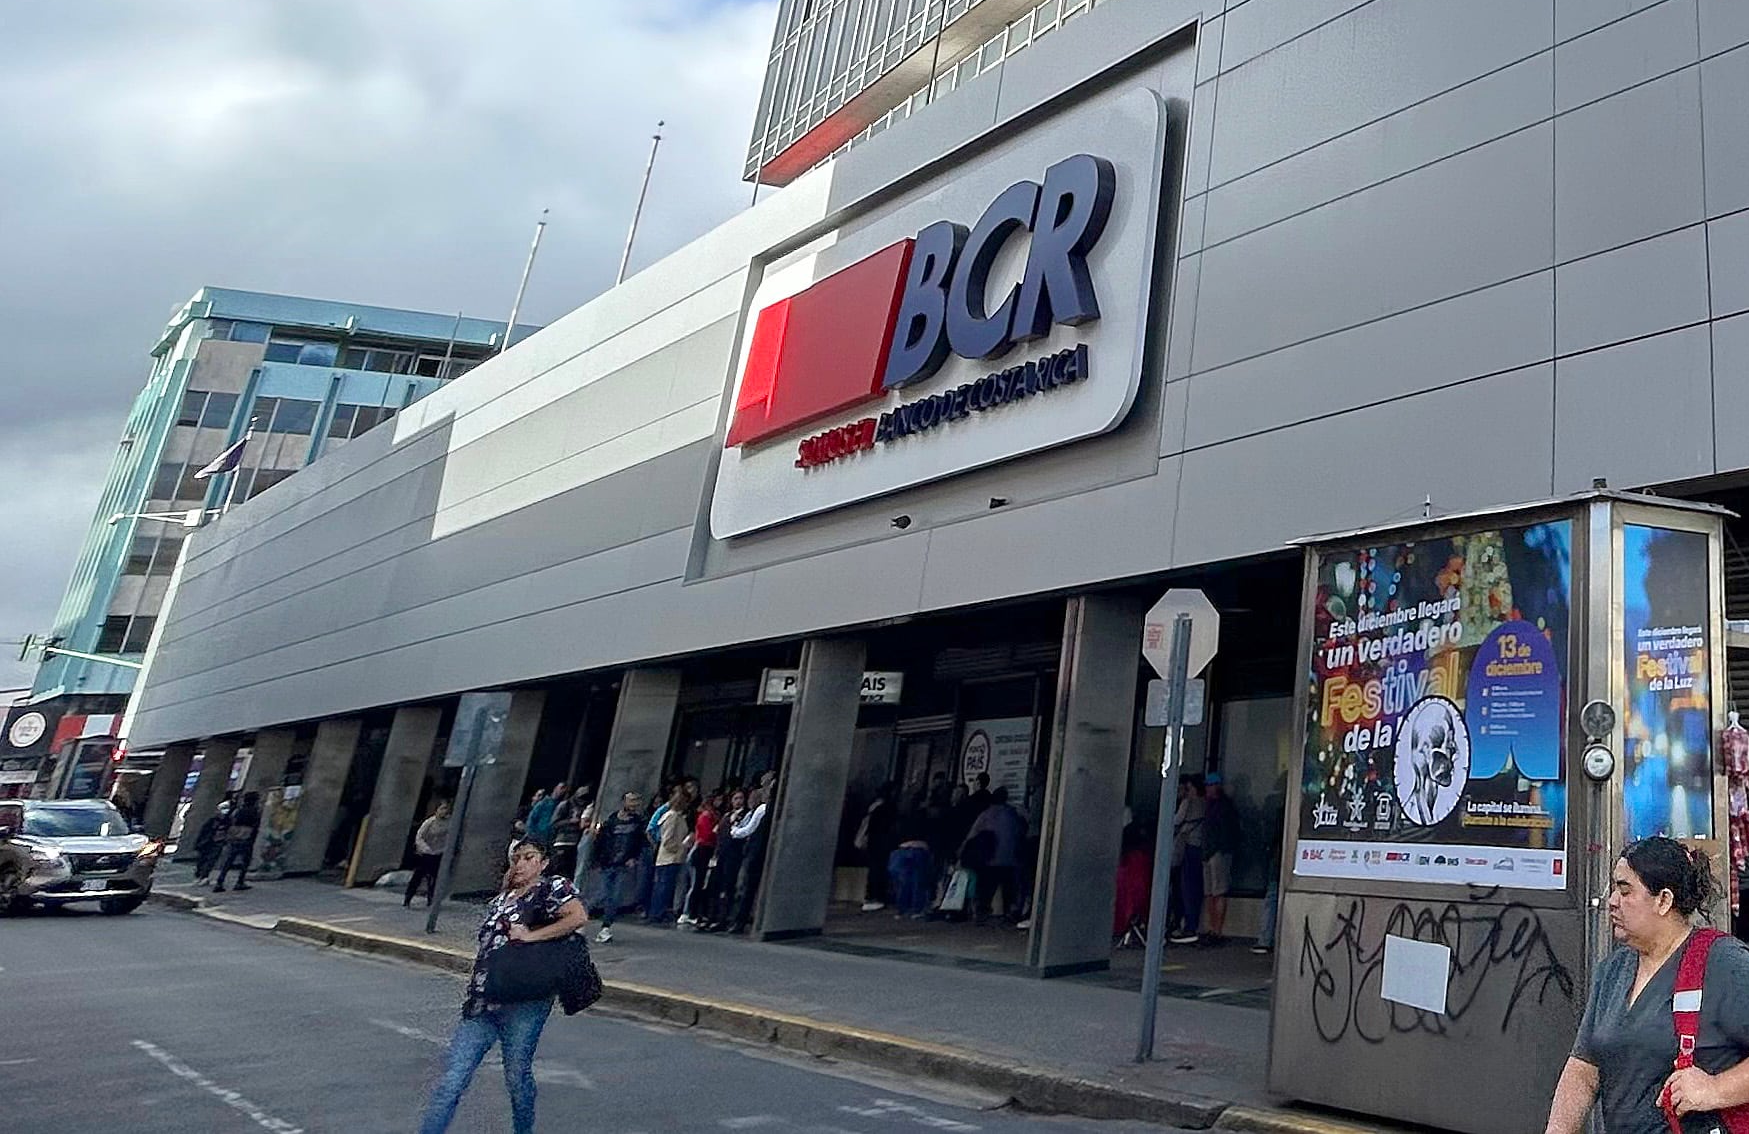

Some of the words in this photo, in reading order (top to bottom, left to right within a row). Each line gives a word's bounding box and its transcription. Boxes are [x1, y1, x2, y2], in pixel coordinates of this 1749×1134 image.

[882, 153, 1117, 390] BCR
[1329, 620, 1356, 639] Este
[1357, 607, 1417, 633] diciembre
[1418, 591, 1461, 620] llegará
[1326, 644, 1354, 669] un
[1358, 620, 1463, 663] verdadero
[1497, 634, 1517, 659] 13
[1518, 643, 1532, 658] de
[1637, 641, 1651, 652] un
[1653, 636, 1703, 651] verdadero
[1486, 658, 1543, 677] diciembre
[1636, 649, 1703, 679] Festival
[1321, 651, 1460, 727] Festival
[1649, 677, 1663, 691] de
[1663, 676, 1673, 690] la
[1674, 675, 1693, 689] Luz
[1344, 722, 1370, 753] de
[1372, 720, 1393, 748] la
[1466, 800, 1477, 813] La
